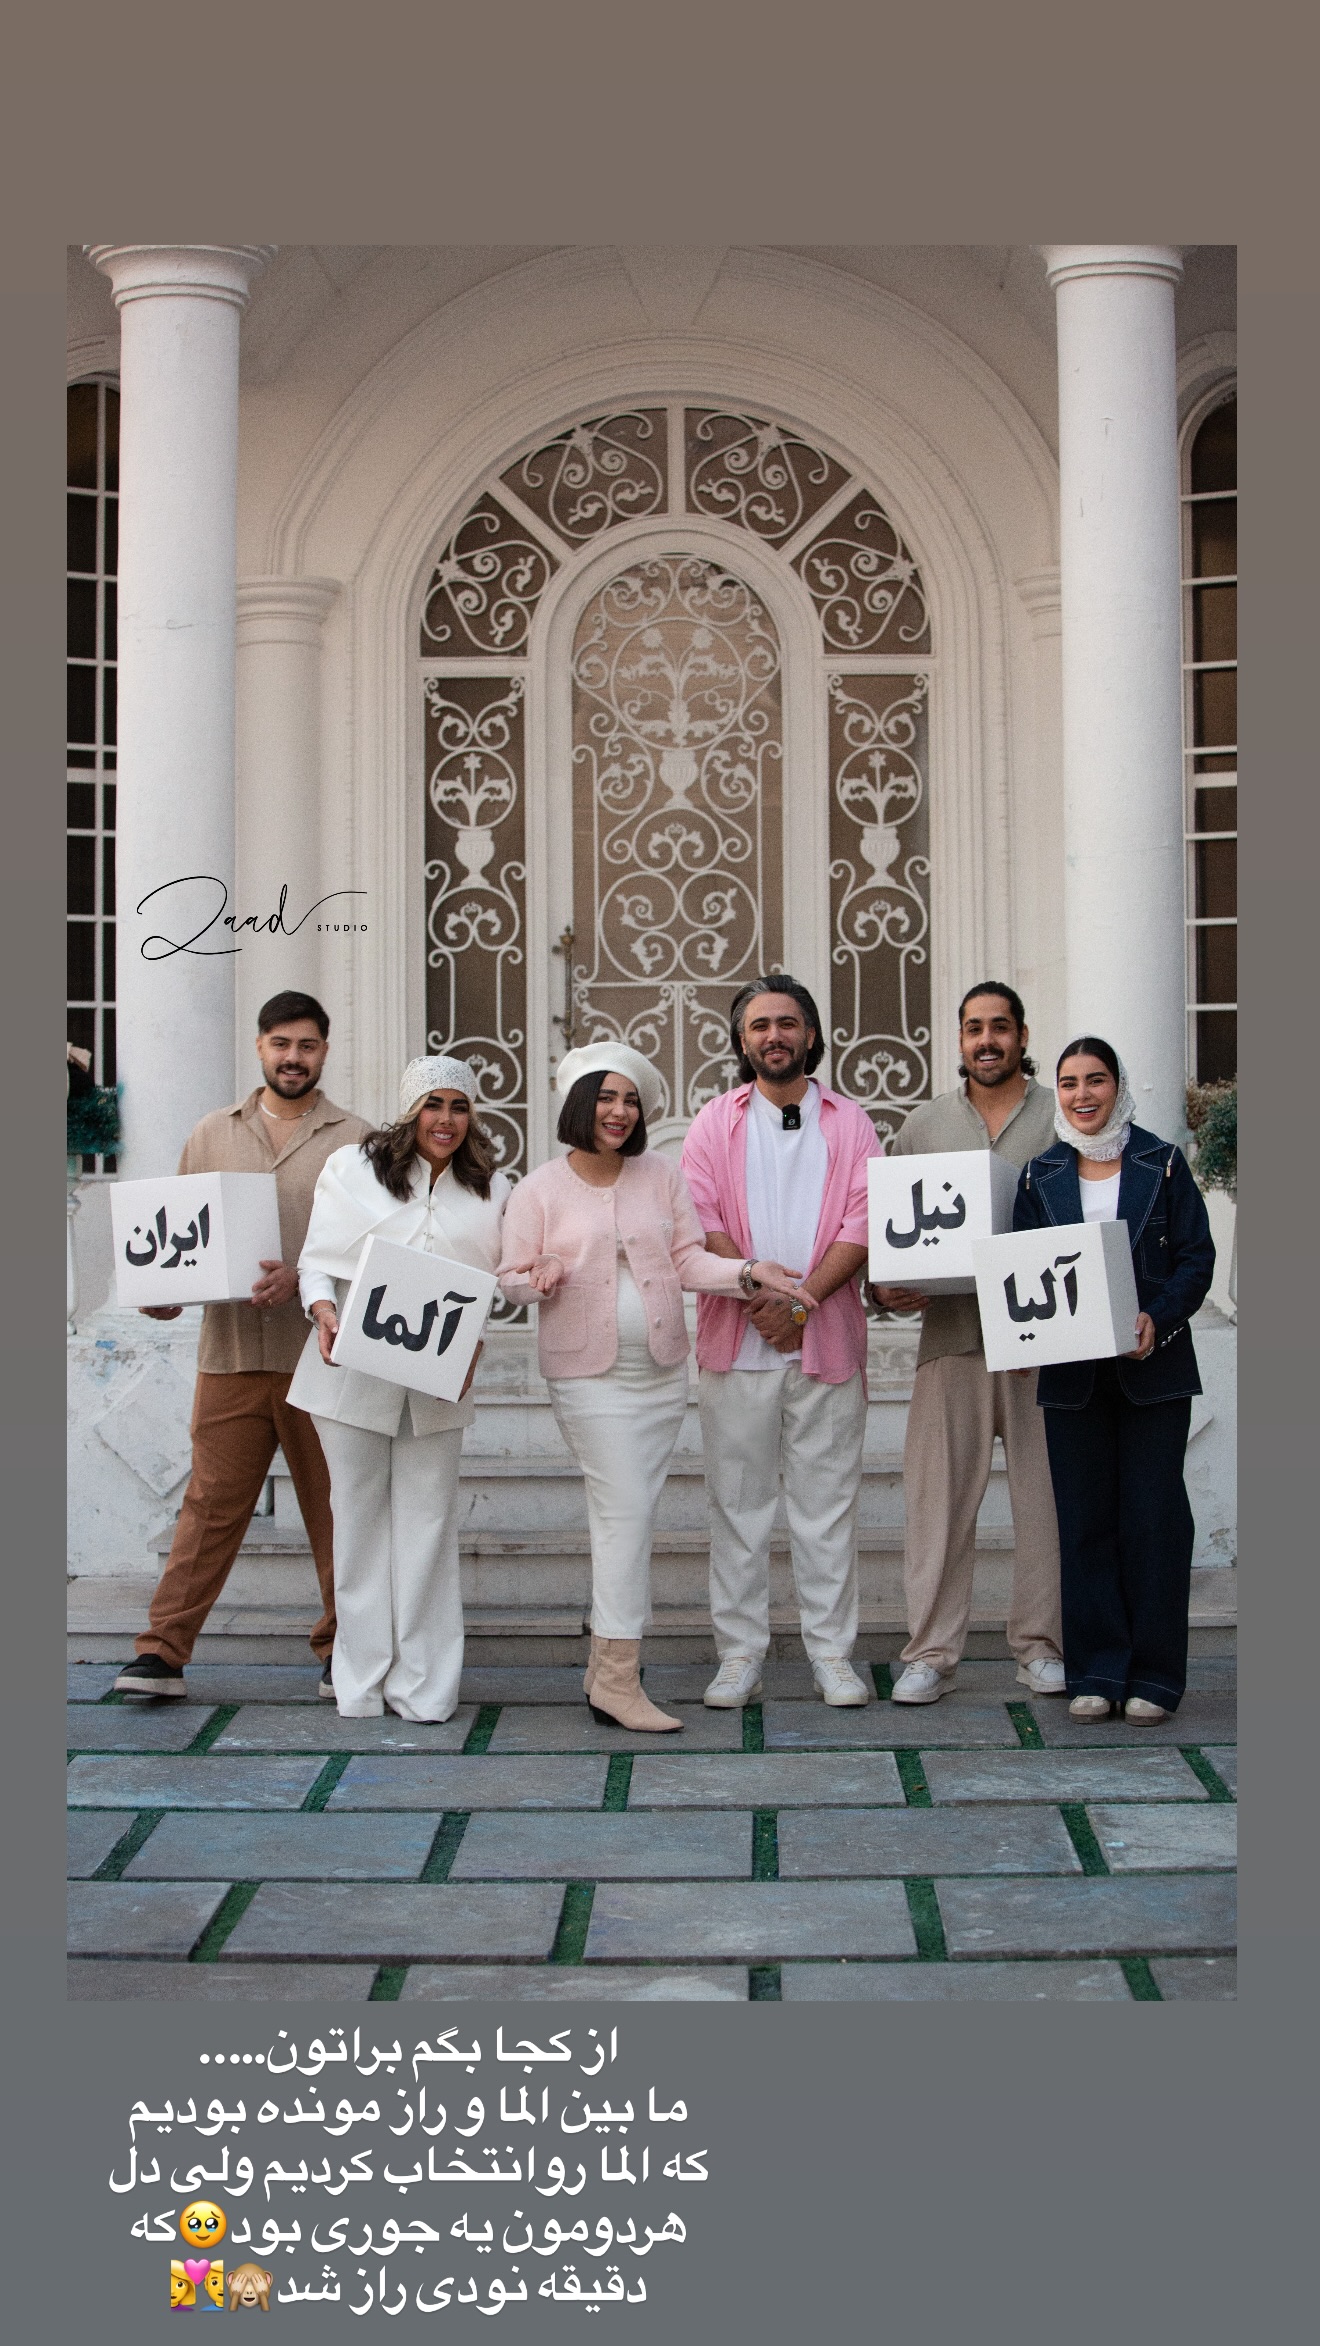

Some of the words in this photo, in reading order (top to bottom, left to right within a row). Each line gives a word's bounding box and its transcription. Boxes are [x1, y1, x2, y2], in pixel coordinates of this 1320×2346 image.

[125, 1203, 210, 1269] ایران
[885, 1178, 967, 1249] نیل
[361, 1284, 477, 1357] آلما
[1003, 1251, 1082, 1342] آلیا
